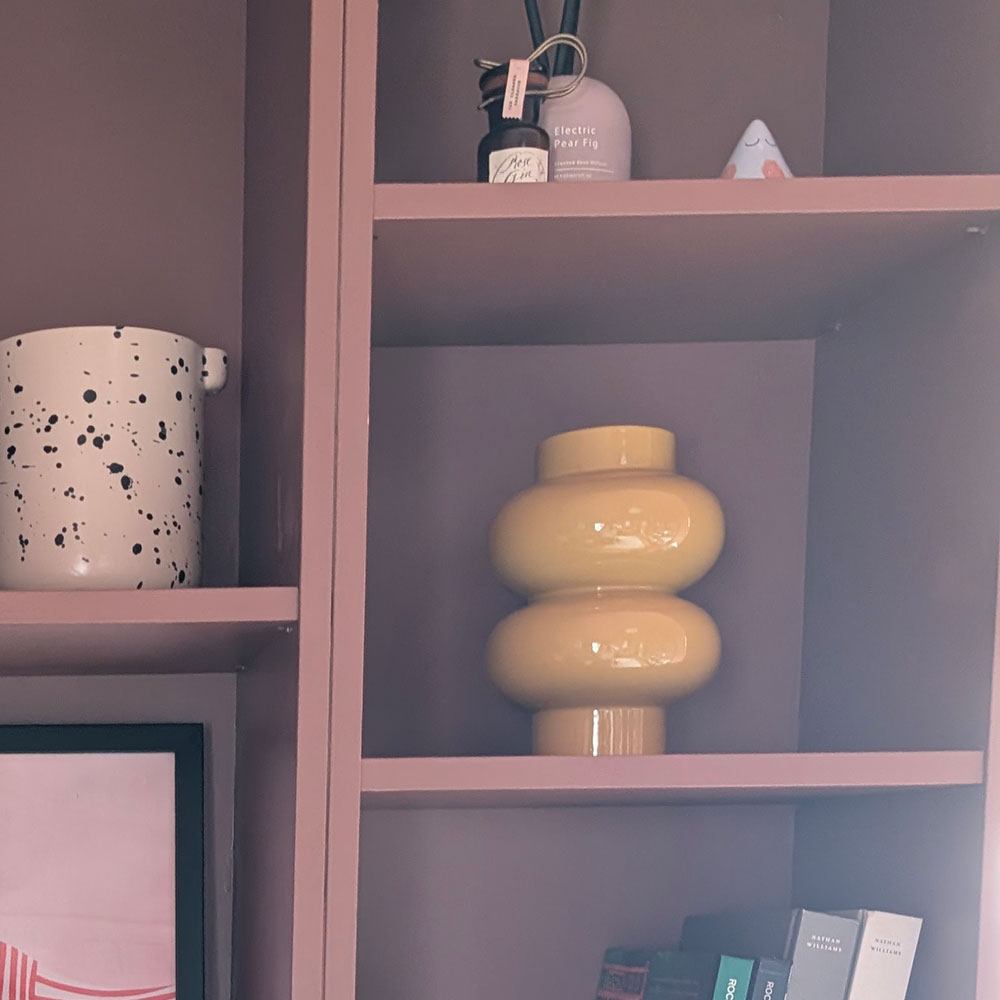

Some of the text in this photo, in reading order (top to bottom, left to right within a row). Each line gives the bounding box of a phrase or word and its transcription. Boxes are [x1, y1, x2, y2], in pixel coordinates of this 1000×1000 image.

[554, 126, 597, 137] Electric
[554, 138, 599, 150] Pear Fig
[811, 935, 841, 944] NATHAN
[875, 938, 901, 947] NATHAN
[806, 942, 842, 952] WILLIAMS
[871, 946, 901, 956] WILLIAMS
